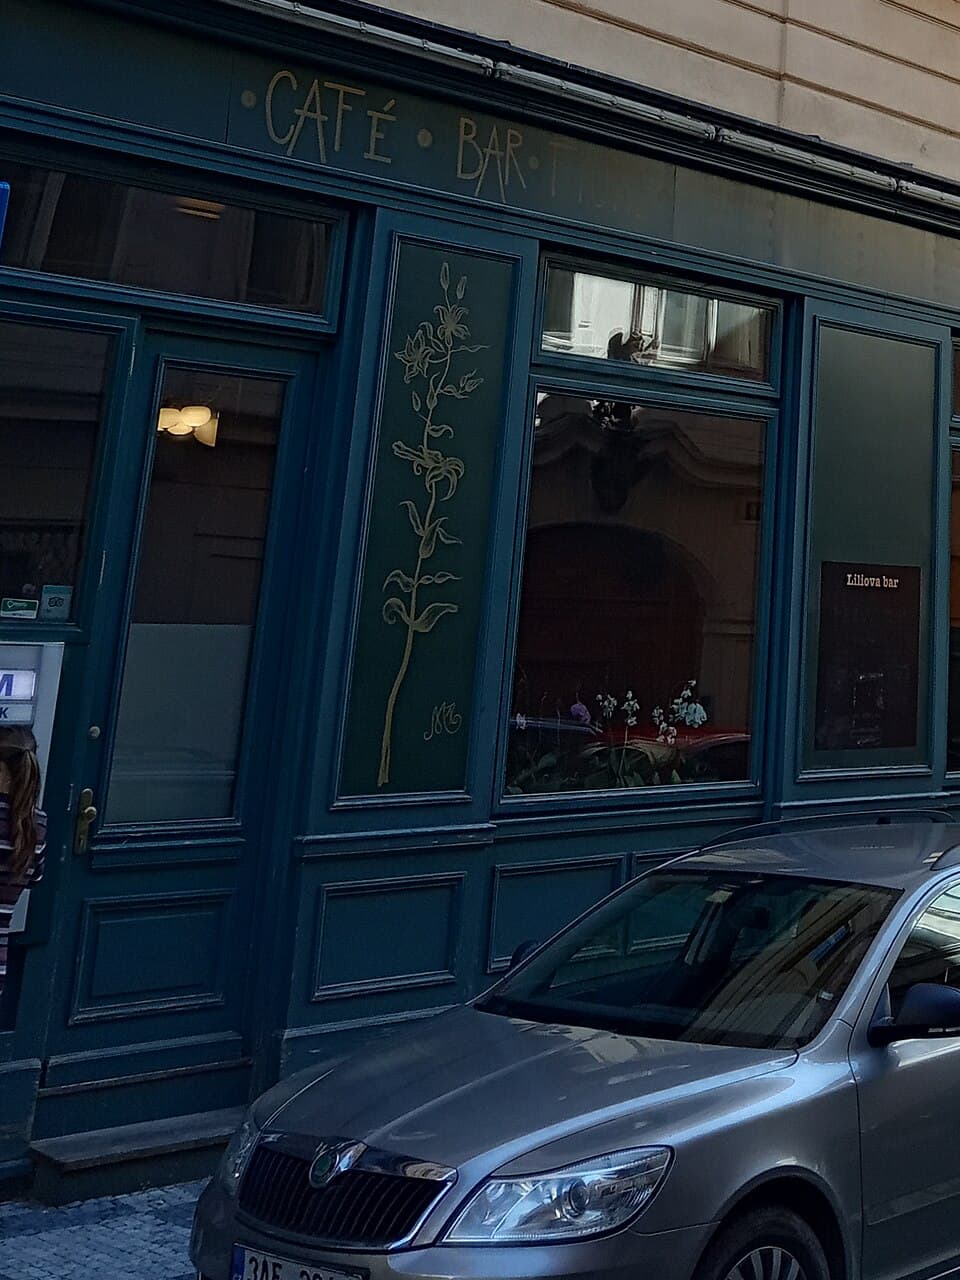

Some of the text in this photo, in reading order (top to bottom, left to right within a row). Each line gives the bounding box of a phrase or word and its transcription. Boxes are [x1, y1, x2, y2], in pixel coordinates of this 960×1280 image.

[266, 70, 397, 164] CAFÉ
[456, 117, 528, 204] BAR
[846, 573, 899, 589] Liliova bar
